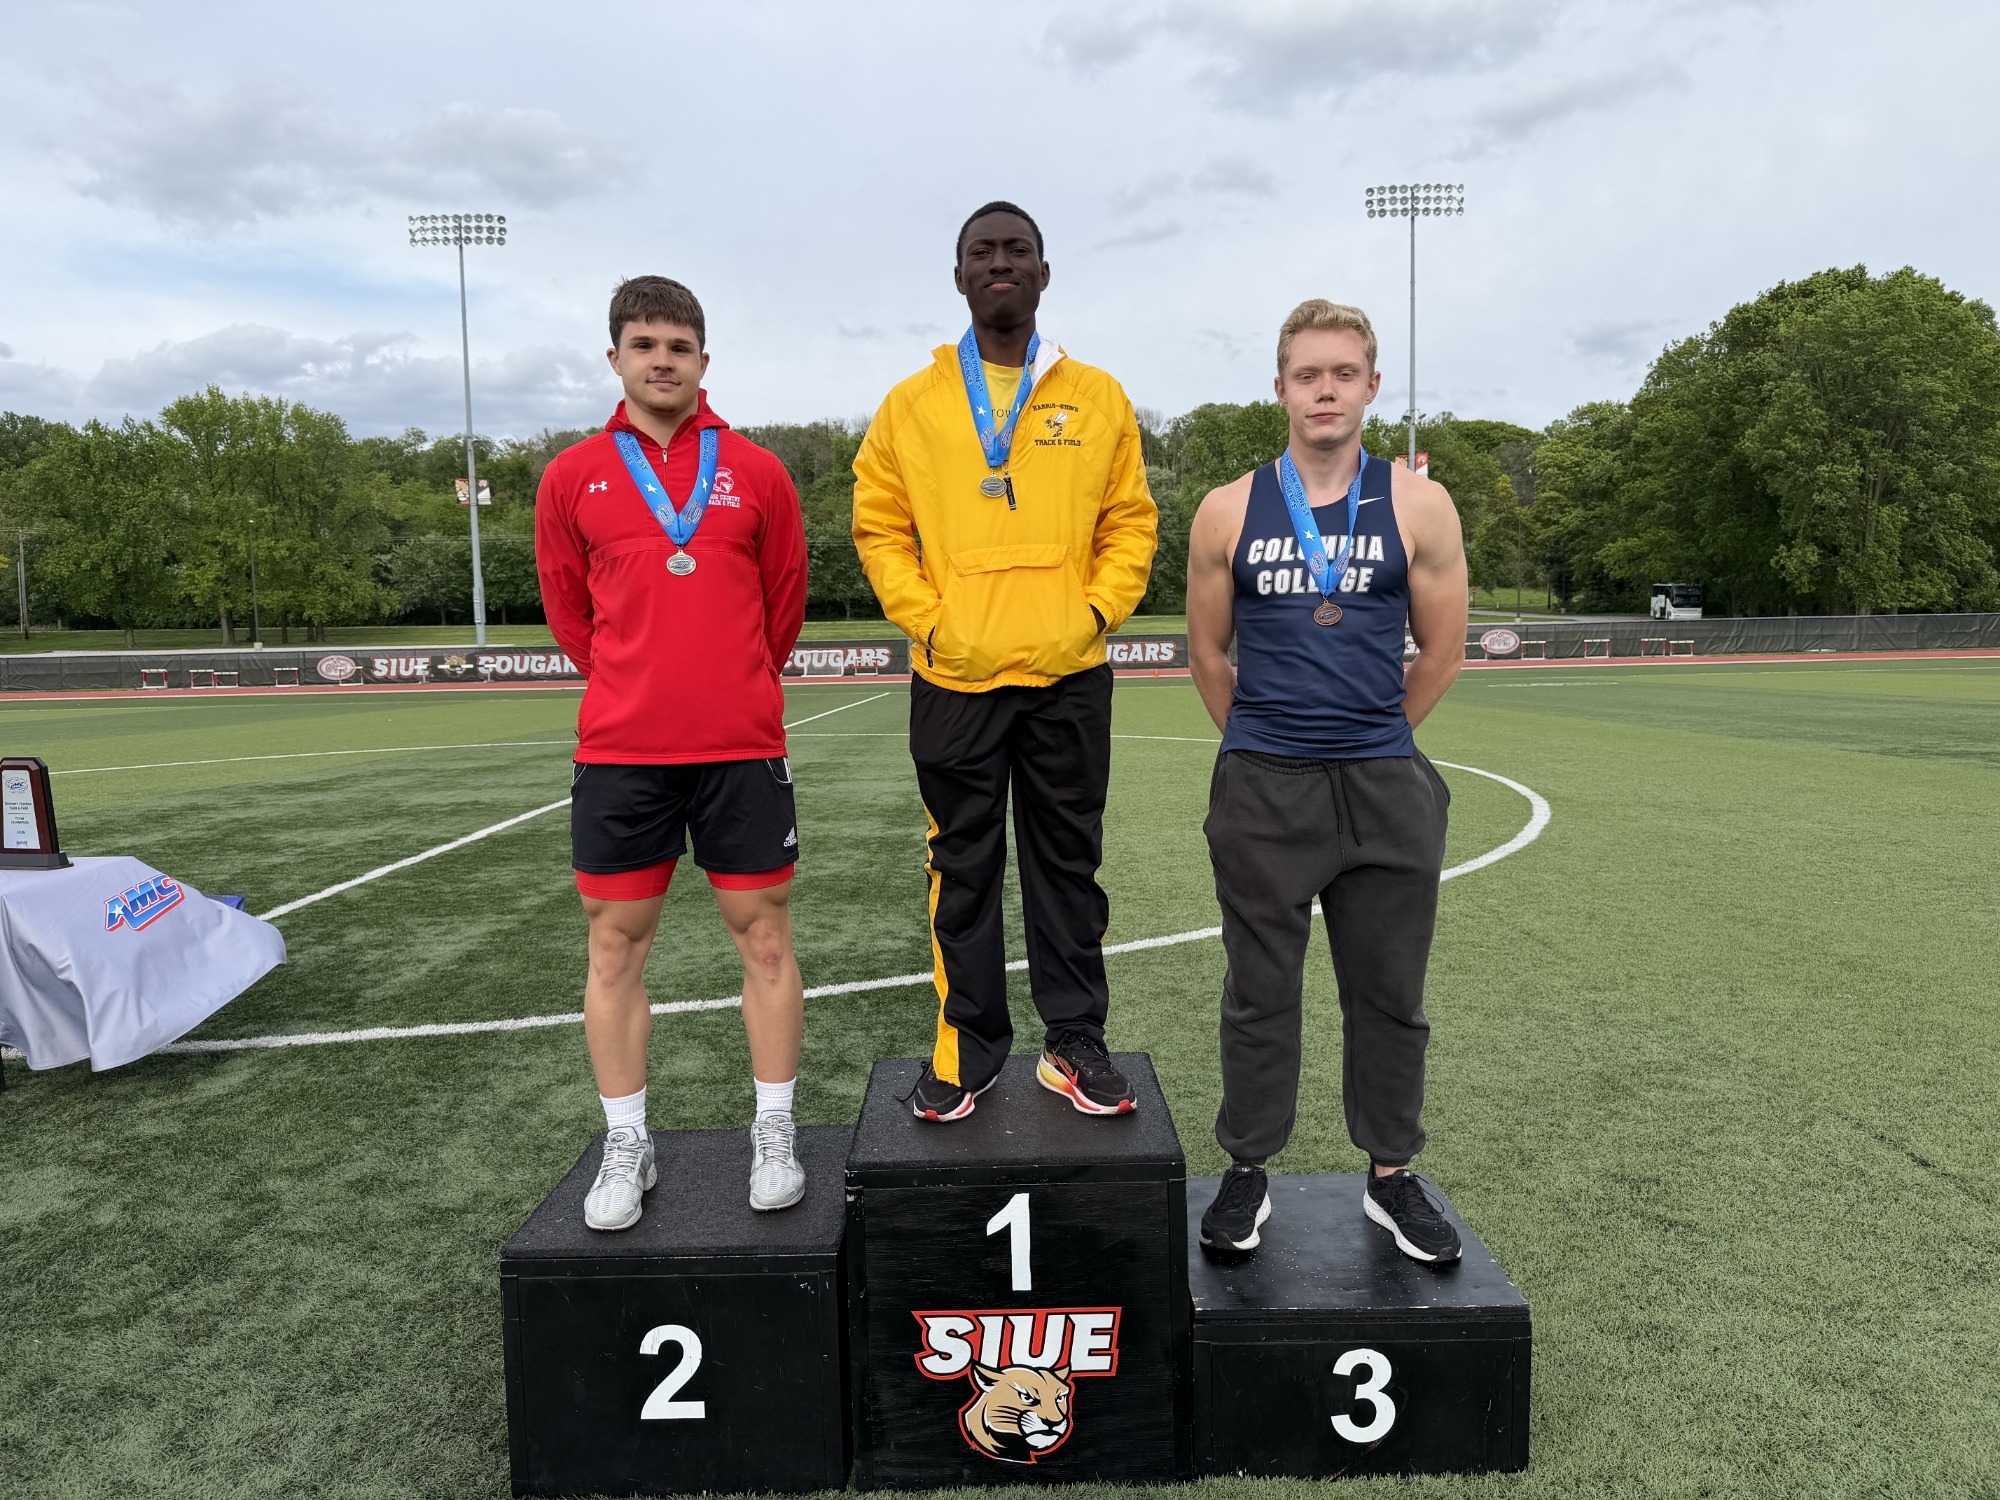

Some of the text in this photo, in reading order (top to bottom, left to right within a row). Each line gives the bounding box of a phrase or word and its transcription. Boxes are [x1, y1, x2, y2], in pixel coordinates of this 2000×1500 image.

[1063, 439, 1081, 447] FIELD
[1294, 483, 1310, 517] MIDWEST
[1246, 534, 1385, 566] COLMBIA
[1256, 566, 1375, 596] COLLGE
[372, 657, 431, 677] SIUE
[478, 654, 579, 675] COUGAR
[1106, 642, 1175, 662] GARS
[104, 874, 185, 932] AMC
[986, 1192, 1031, 1290] 1
[918, 1310, 1116, 1376] SIUE
[639, 1324, 705, 1419] 2
[1330, 1348, 1395, 1443] 3
